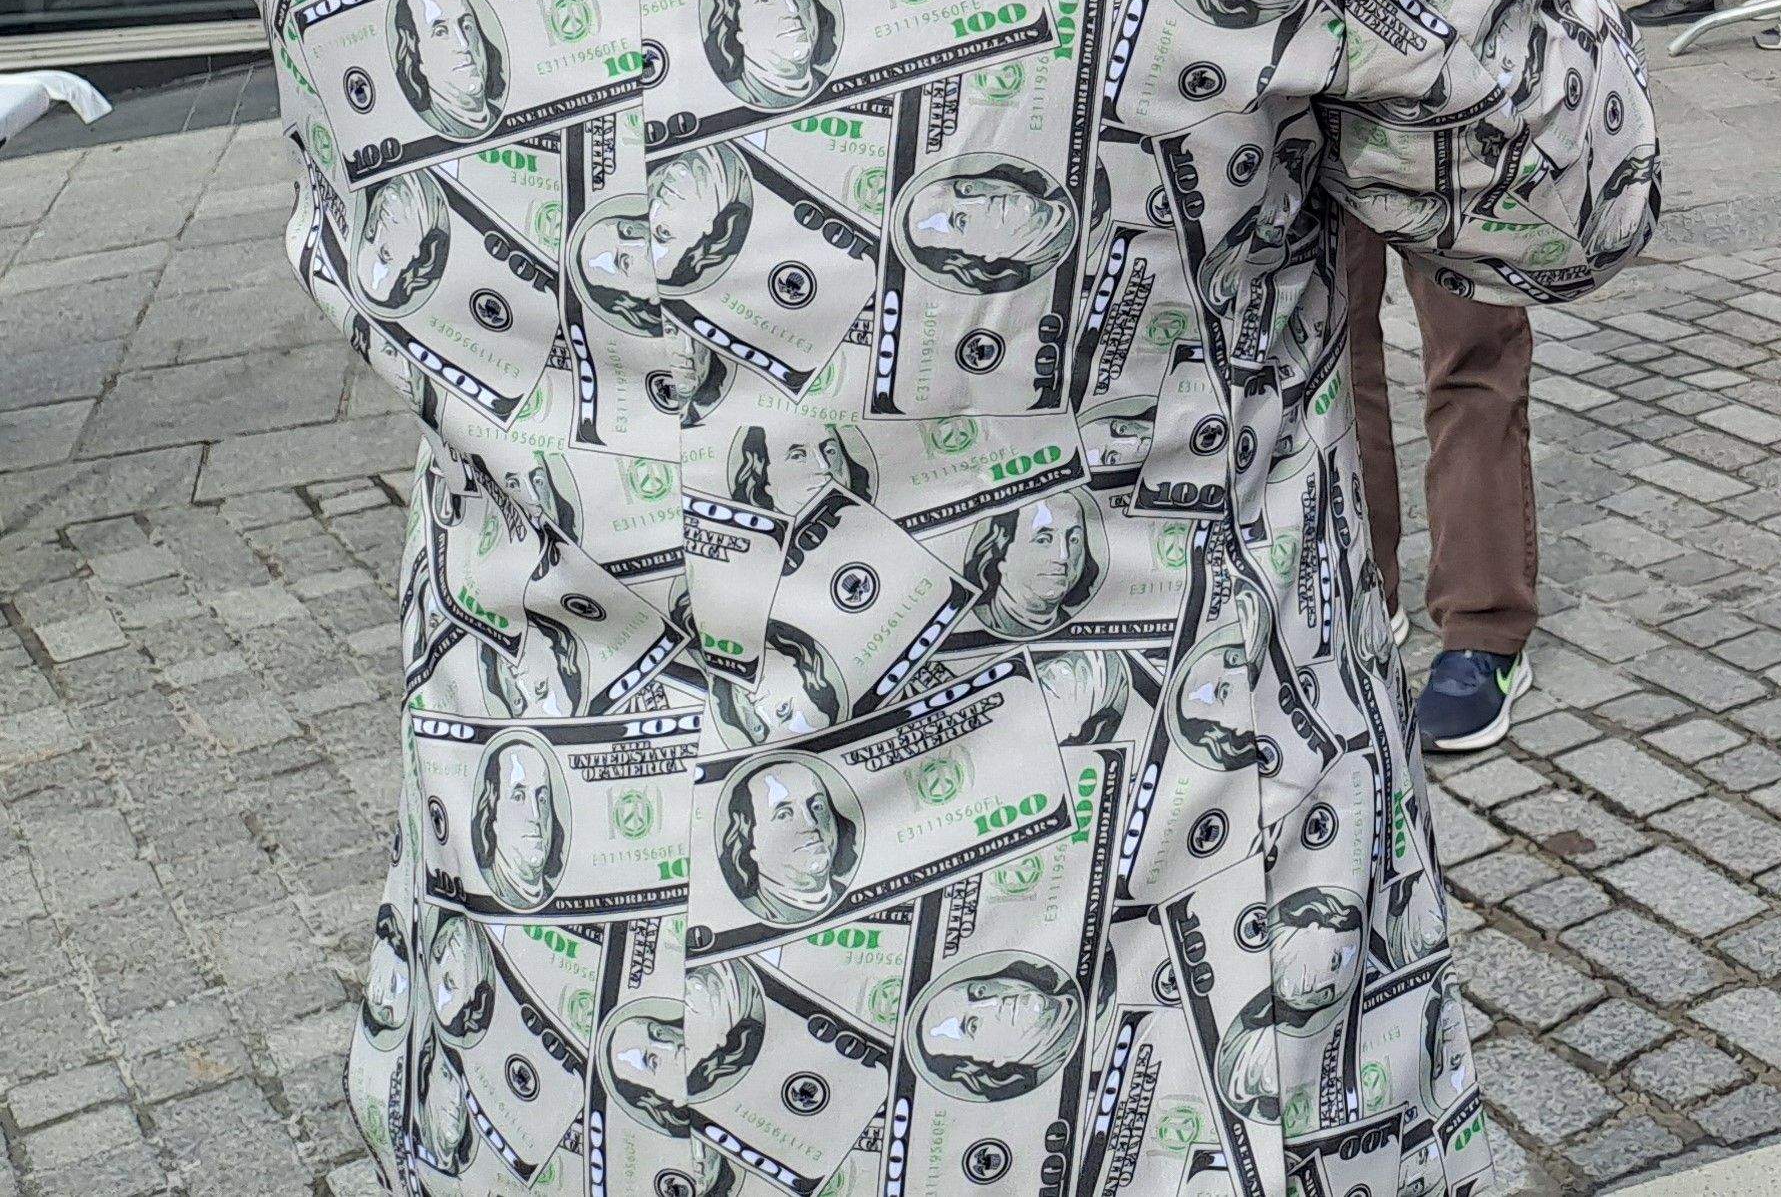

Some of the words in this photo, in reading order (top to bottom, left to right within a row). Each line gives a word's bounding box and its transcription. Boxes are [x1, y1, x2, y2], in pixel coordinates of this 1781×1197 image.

[951, 0, 1029, 38] 100
[535, 38, 631, 75] E31119560FE
[832, 74, 868, 93] ONE
[867, 50, 955, 84] HUNDRED
[955, 28, 1039, 60] DOLLARS
[506, 109, 538, 126] ONE
[536, 89, 608, 118] HUNDRED
[791, 115, 862, 139] 100
[1072, 67, 1090, 152] HUNDRED
[351, 135, 404, 172] 100
[1068, 152, 1082, 186] ONE
[1169, 148, 1209, 221] 100
[476, 228, 555, 294] 100
[787, 199, 871, 260] 100
[1086, 235, 1127, 331] 100
[1115, 271, 1154, 360] AMERICA
[688, 316, 791, 380] 100
[875, 289, 899, 394] 100
[1031, 312, 1064, 391] 100
[1095, 327, 1126, 395] UNITED
[1114, 256, 1148, 330] STATES
[407, 340, 501, 407] 100
[569, 323, 599, 420] 100
[988, 443, 1064, 482] 100
[1156, 482, 1225, 506] 100
[903, 490, 993, 529] HUNDRED
[992, 466, 1073, 501] DOLLARS
[770, 506, 844, 580] 100
[850, 577, 935, 666] E31119560FE
[1316, 540, 1334, 643] 100
[870, 603, 963, 698] 100
[1071, 624, 1106, 637] ONE
[602, 638, 677, 702] 100
[904, 660, 1016, 717] 100
[414, 715, 475, 739] 100
[613, 740, 649, 751] THE
[842, 724, 924, 768] UNITED
[918, 691, 1005, 736] STATES
[864, 751, 895, 774] OF
[891, 712, 995, 762] AMERICA
[1270, 679, 1329, 756] 100
[570, 748, 633, 767] UNITED
[632, 742, 699, 762] STATES
[582, 765, 603, 781] OF
[602, 758, 686, 779] AMERICA
[972, 792, 1050, 835] 100
[1071, 767, 1097, 842] 100
[1097, 759, 1118, 845] DOLLARS
[1116, 762, 1159, 878] 100
[850, 881, 890, 904] ONE
[888, 848, 977, 890] HUNDRED
[977, 816, 1059, 856] DOLLARS
[1084, 847, 1106, 937] HUNDRED
[555, 897, 583, 910] ONE
[582, 889, 657, 907] HUNDRED
[807, 928, 879, 948] 100
[1079, 938, 1094, 975] ONE
[1177, 913, 1217, 996] 100
[511, 1002, 586, 1075] 100
[803, 1012, 887, 1072] 100
[1093, 1022, 1132, 1135] 100
[1120, 1044, 1153, 1125] STATES
[1124, 1059, 1161, 1159] AMERICA
[700, 1123, 799, 1186] 100
[885, 1097, 909, 1197] 100
[1230, 1120, 1250, 1156] ONE
[1335, 1128, 1389, 1161] 100
